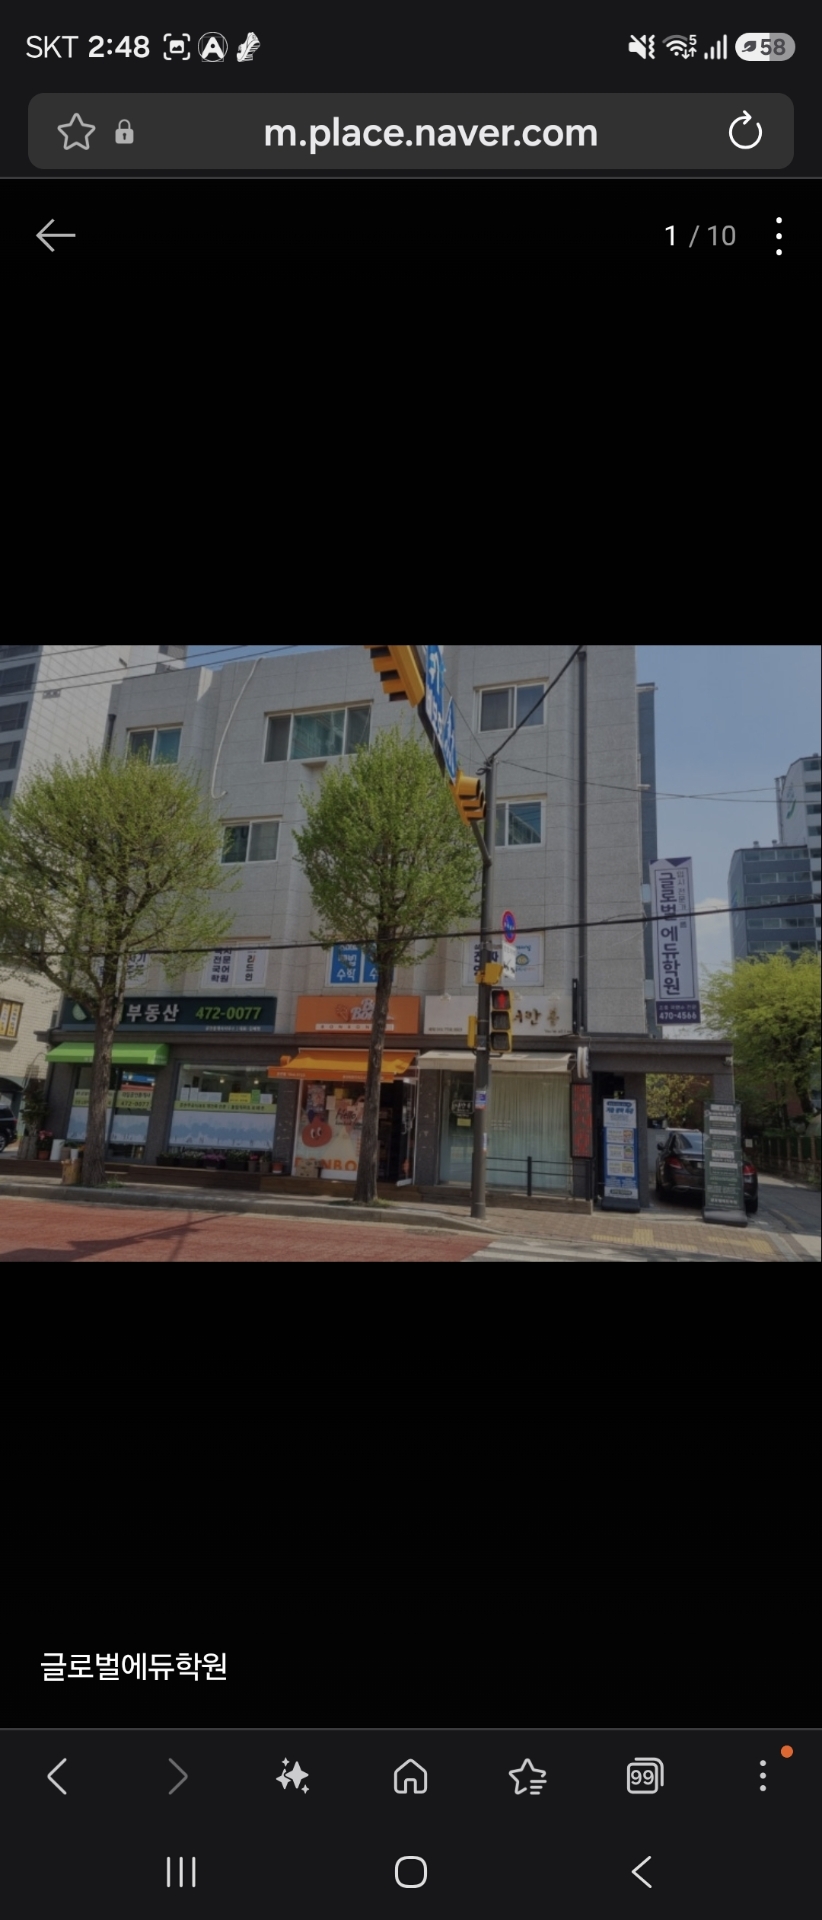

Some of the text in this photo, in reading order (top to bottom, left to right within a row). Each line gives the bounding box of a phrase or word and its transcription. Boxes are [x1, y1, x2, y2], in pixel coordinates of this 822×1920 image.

[26, 35, 150, 59] SKT 2:48
[760, 38, 786, 56] 58
[265, 116, 598, 154] m.place.naver.com
[665, 225, 675, 246] 1
[707, 225, 736, 246] 10
[213, 955, 231, 965] 전문
[660, 926, 681, 995] 에듀학원
[212, 965, 230, 974] 국어
[336, 967, 357, 982] 수학
[210, 974, 229, 983] 학원
[126, 1003, 180, 1023] 부동산
[195, 1006, 262, 1021] 472-0077
[658, 1011, 697, 1020] 470-4566
[631, 1769, 654, 1785] 99
